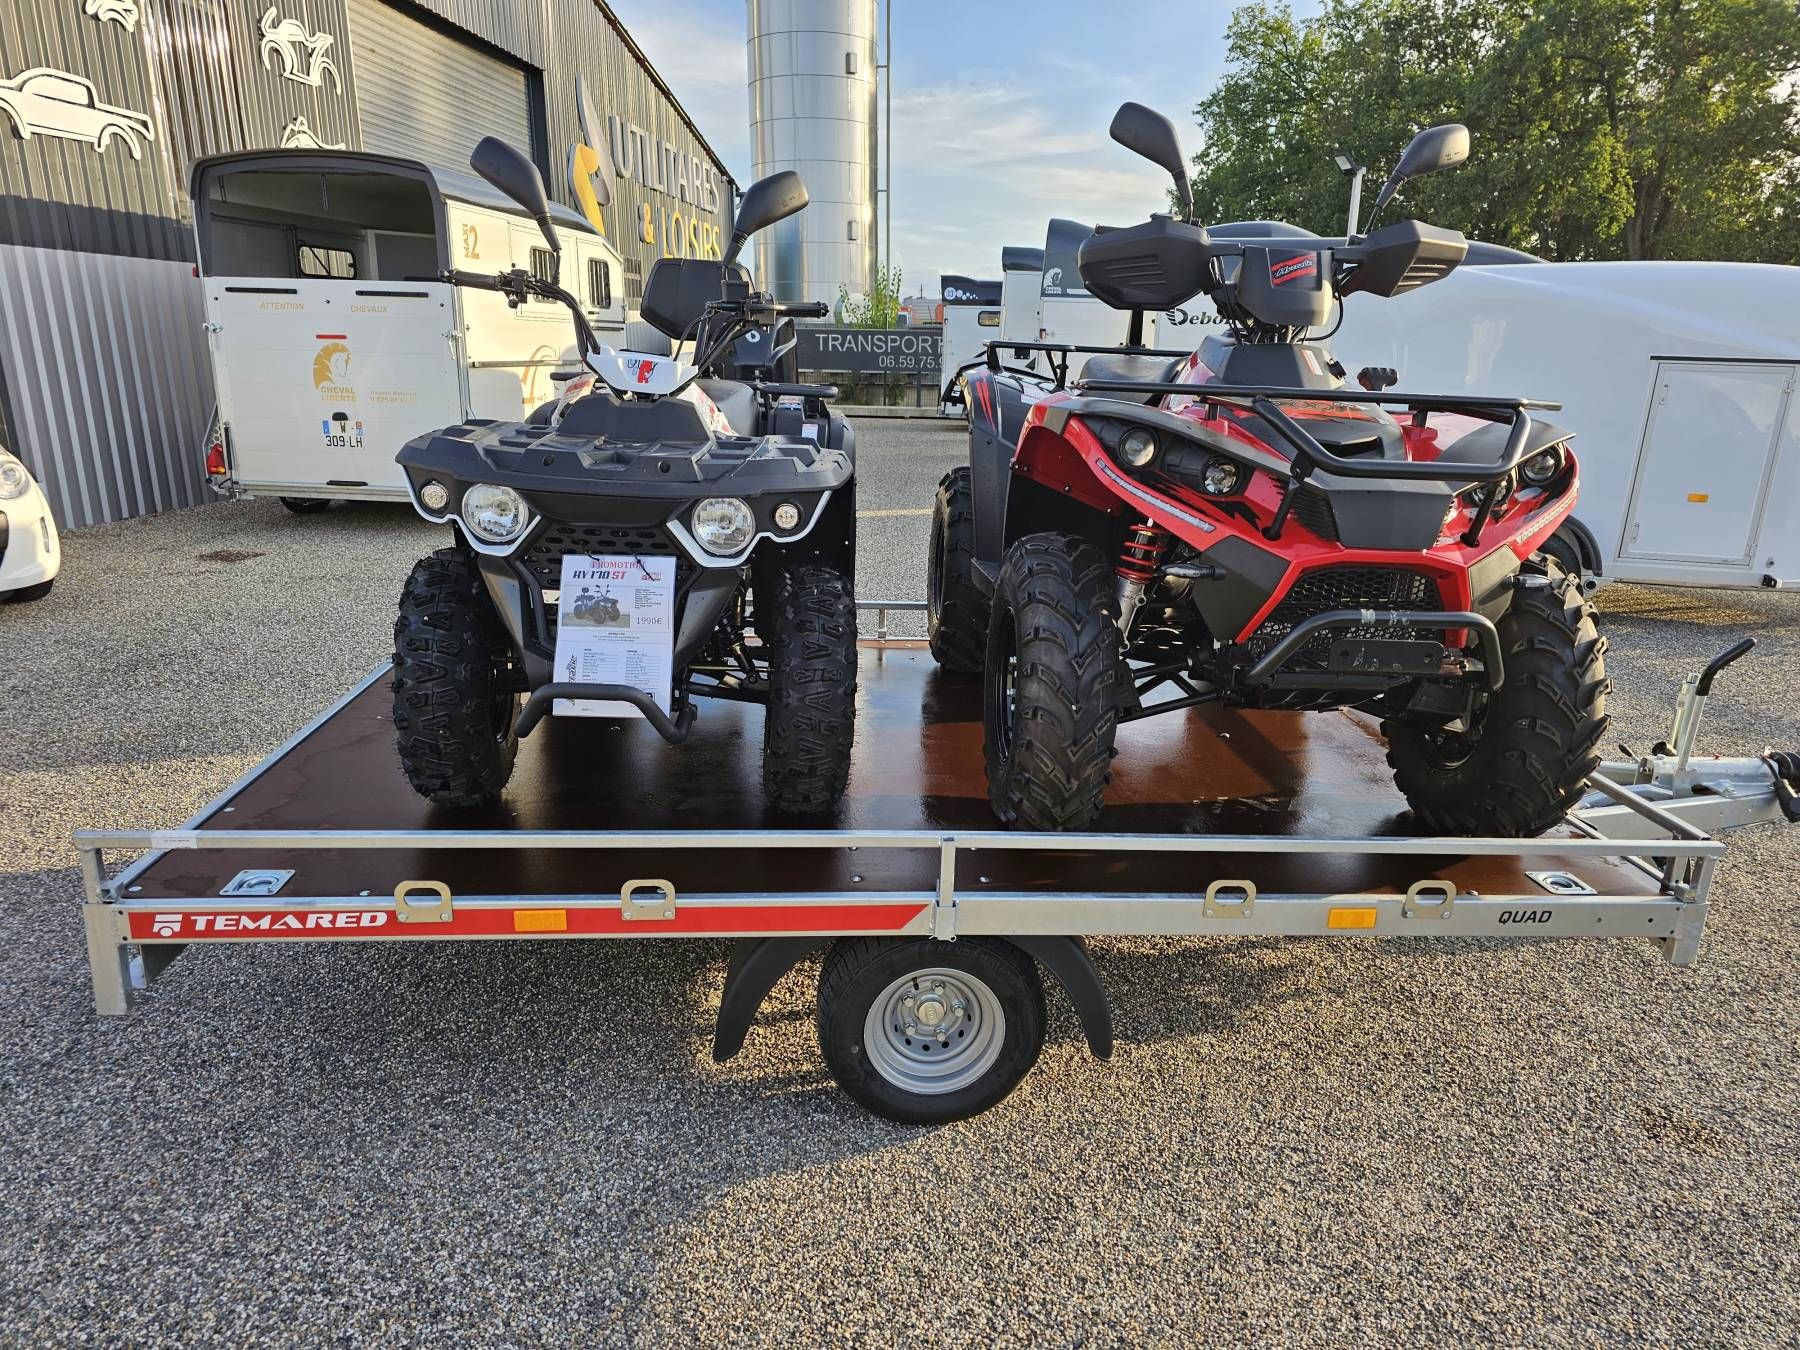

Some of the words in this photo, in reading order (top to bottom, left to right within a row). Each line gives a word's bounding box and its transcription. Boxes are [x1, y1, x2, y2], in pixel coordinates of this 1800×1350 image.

[608, 115, 720, 215] UTILITAIRES
[638, 202, 655, 244] &
[656, 206, 722, 260] LOISIRS
[461, 223, 471, 259] MAXI
[469, 225, 480, 260] 2
[259, 302, 305, 310] ATTENTION
[350, 305, 389, 313] CHEVAUX
[320, 386, 356, 395] CHEVAL
[573, 571, 588, 579] HY
[590, 570, 610, 579] 170
[636, 617, 664, 625] 1990€
[190, 911, 388, 931] TEMARED
[1498, 910, 1553, 924] QUAD
